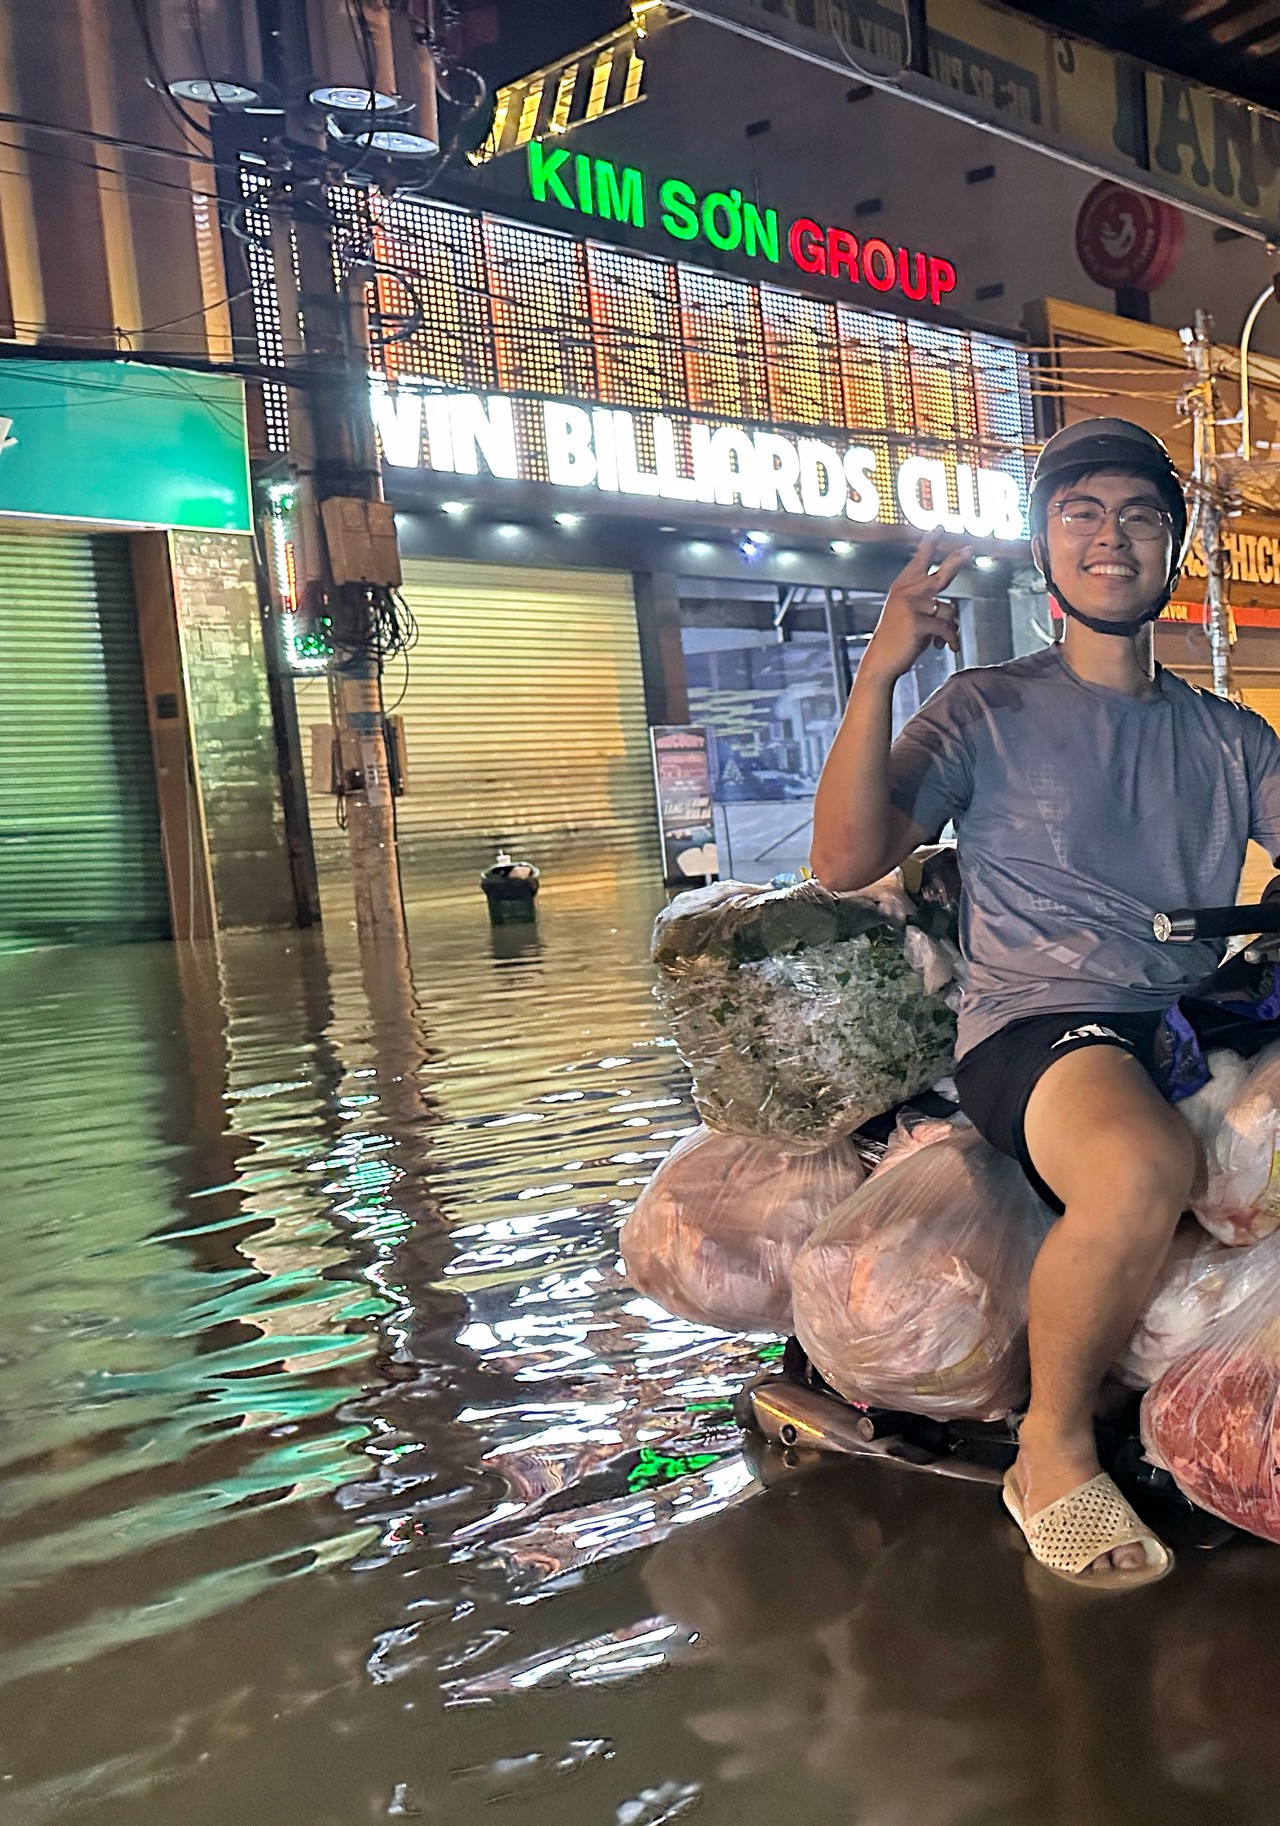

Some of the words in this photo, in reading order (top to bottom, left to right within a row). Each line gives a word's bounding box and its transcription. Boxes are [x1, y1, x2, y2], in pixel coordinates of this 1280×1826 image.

[529, 141, 645, 228] KIM
[659, 179, 779, 263] SƠN
[789, 218, 957, 306] GROUP
[543, 400, 881, 522] BILLIARDS
[898, 456, 1024, 541] CLUB
